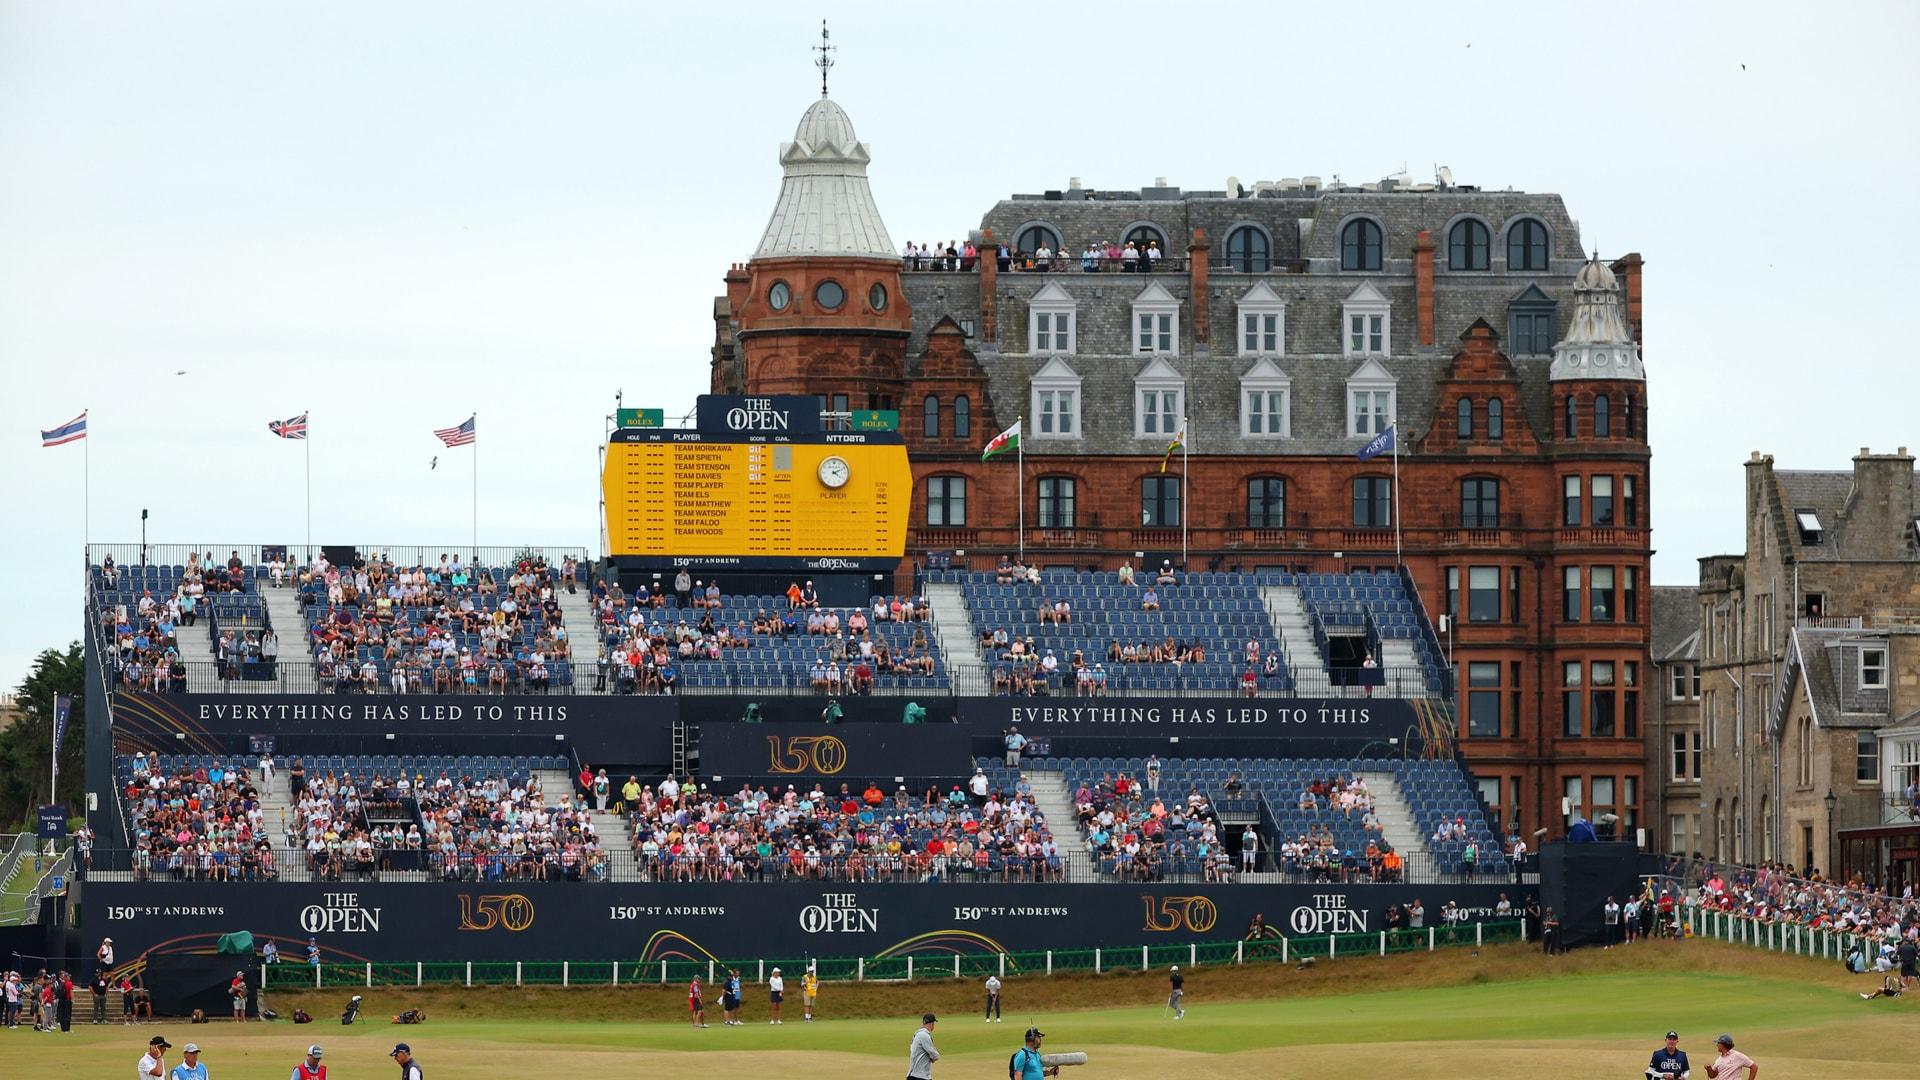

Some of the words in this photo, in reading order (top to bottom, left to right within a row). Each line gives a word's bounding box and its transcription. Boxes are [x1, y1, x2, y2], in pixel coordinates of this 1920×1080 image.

[745, 399, 771, 410] THE
[626, 418, 654, 426] ROLEX
[727, 408, 789, 430] OPEN
[861, 420, 889, 428] ROLEX
[200, 705, 352, 719] EVERYTHING
[365, 706, 408, 719] HAS
[421, 706, 462, 719] LED
[474, 706, 502, 720] TO
[514, 706, 566, 720] THIS
[1012, 708, 1160, 722] EVERYTHING
[1172, 709, 1215, 723] HAS
[1227, 709, 1267, 722] LED
[1279, 709, 1306, 723] TO
[1318, 709, 1369, 723] THIS
[766, 735, 846, 774] 150
[324, 893, 358, 907] THE
[823, 894, 856, 907] THE
[1313, 895, 1346, 908] THE
[146, 907, 159, 915] ST
[164, 907, 223, 915] ANDREWS
[301, 903, 381, 932] OPEN
[457, 893, 534, 931] 150
[666, 907, 724, 915] ANDREWS
[800, 904, 879, 932] OPEN
[1142, 895, 1217, 933] 150
[1479, 908, 1492, 916] ST
[1291, 905, 1368, 933] OPEN
[1661, 1062, 1681, 1070] OPEN
